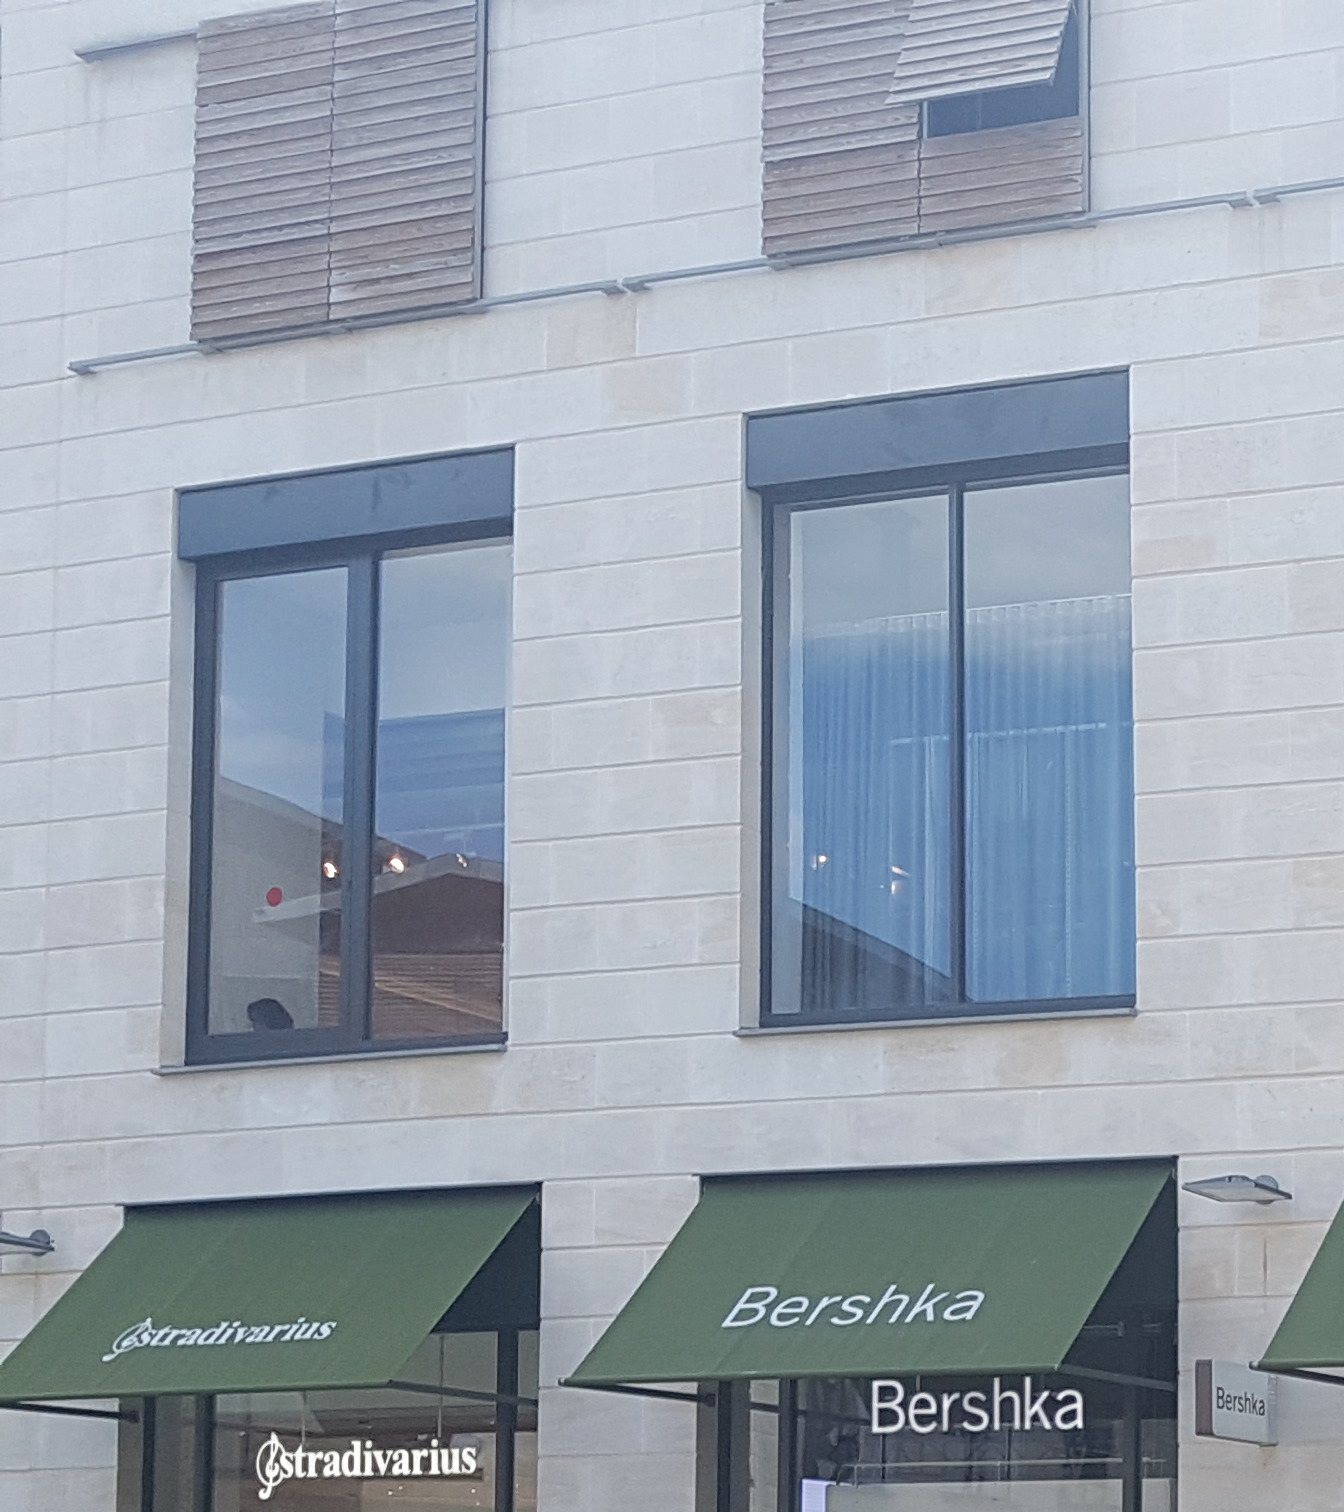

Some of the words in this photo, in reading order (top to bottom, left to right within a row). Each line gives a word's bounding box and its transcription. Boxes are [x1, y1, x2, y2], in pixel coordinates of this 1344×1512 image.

[721, 1283, 986, 1328] Bershka
[134, 1316, 337, 1348] stradivarius
[870, 1376, 1084, 1434] Bershka
[1215, 1386, 1266, 1417] Bershka
[279, 1438, 478, 1479] stradivarius
